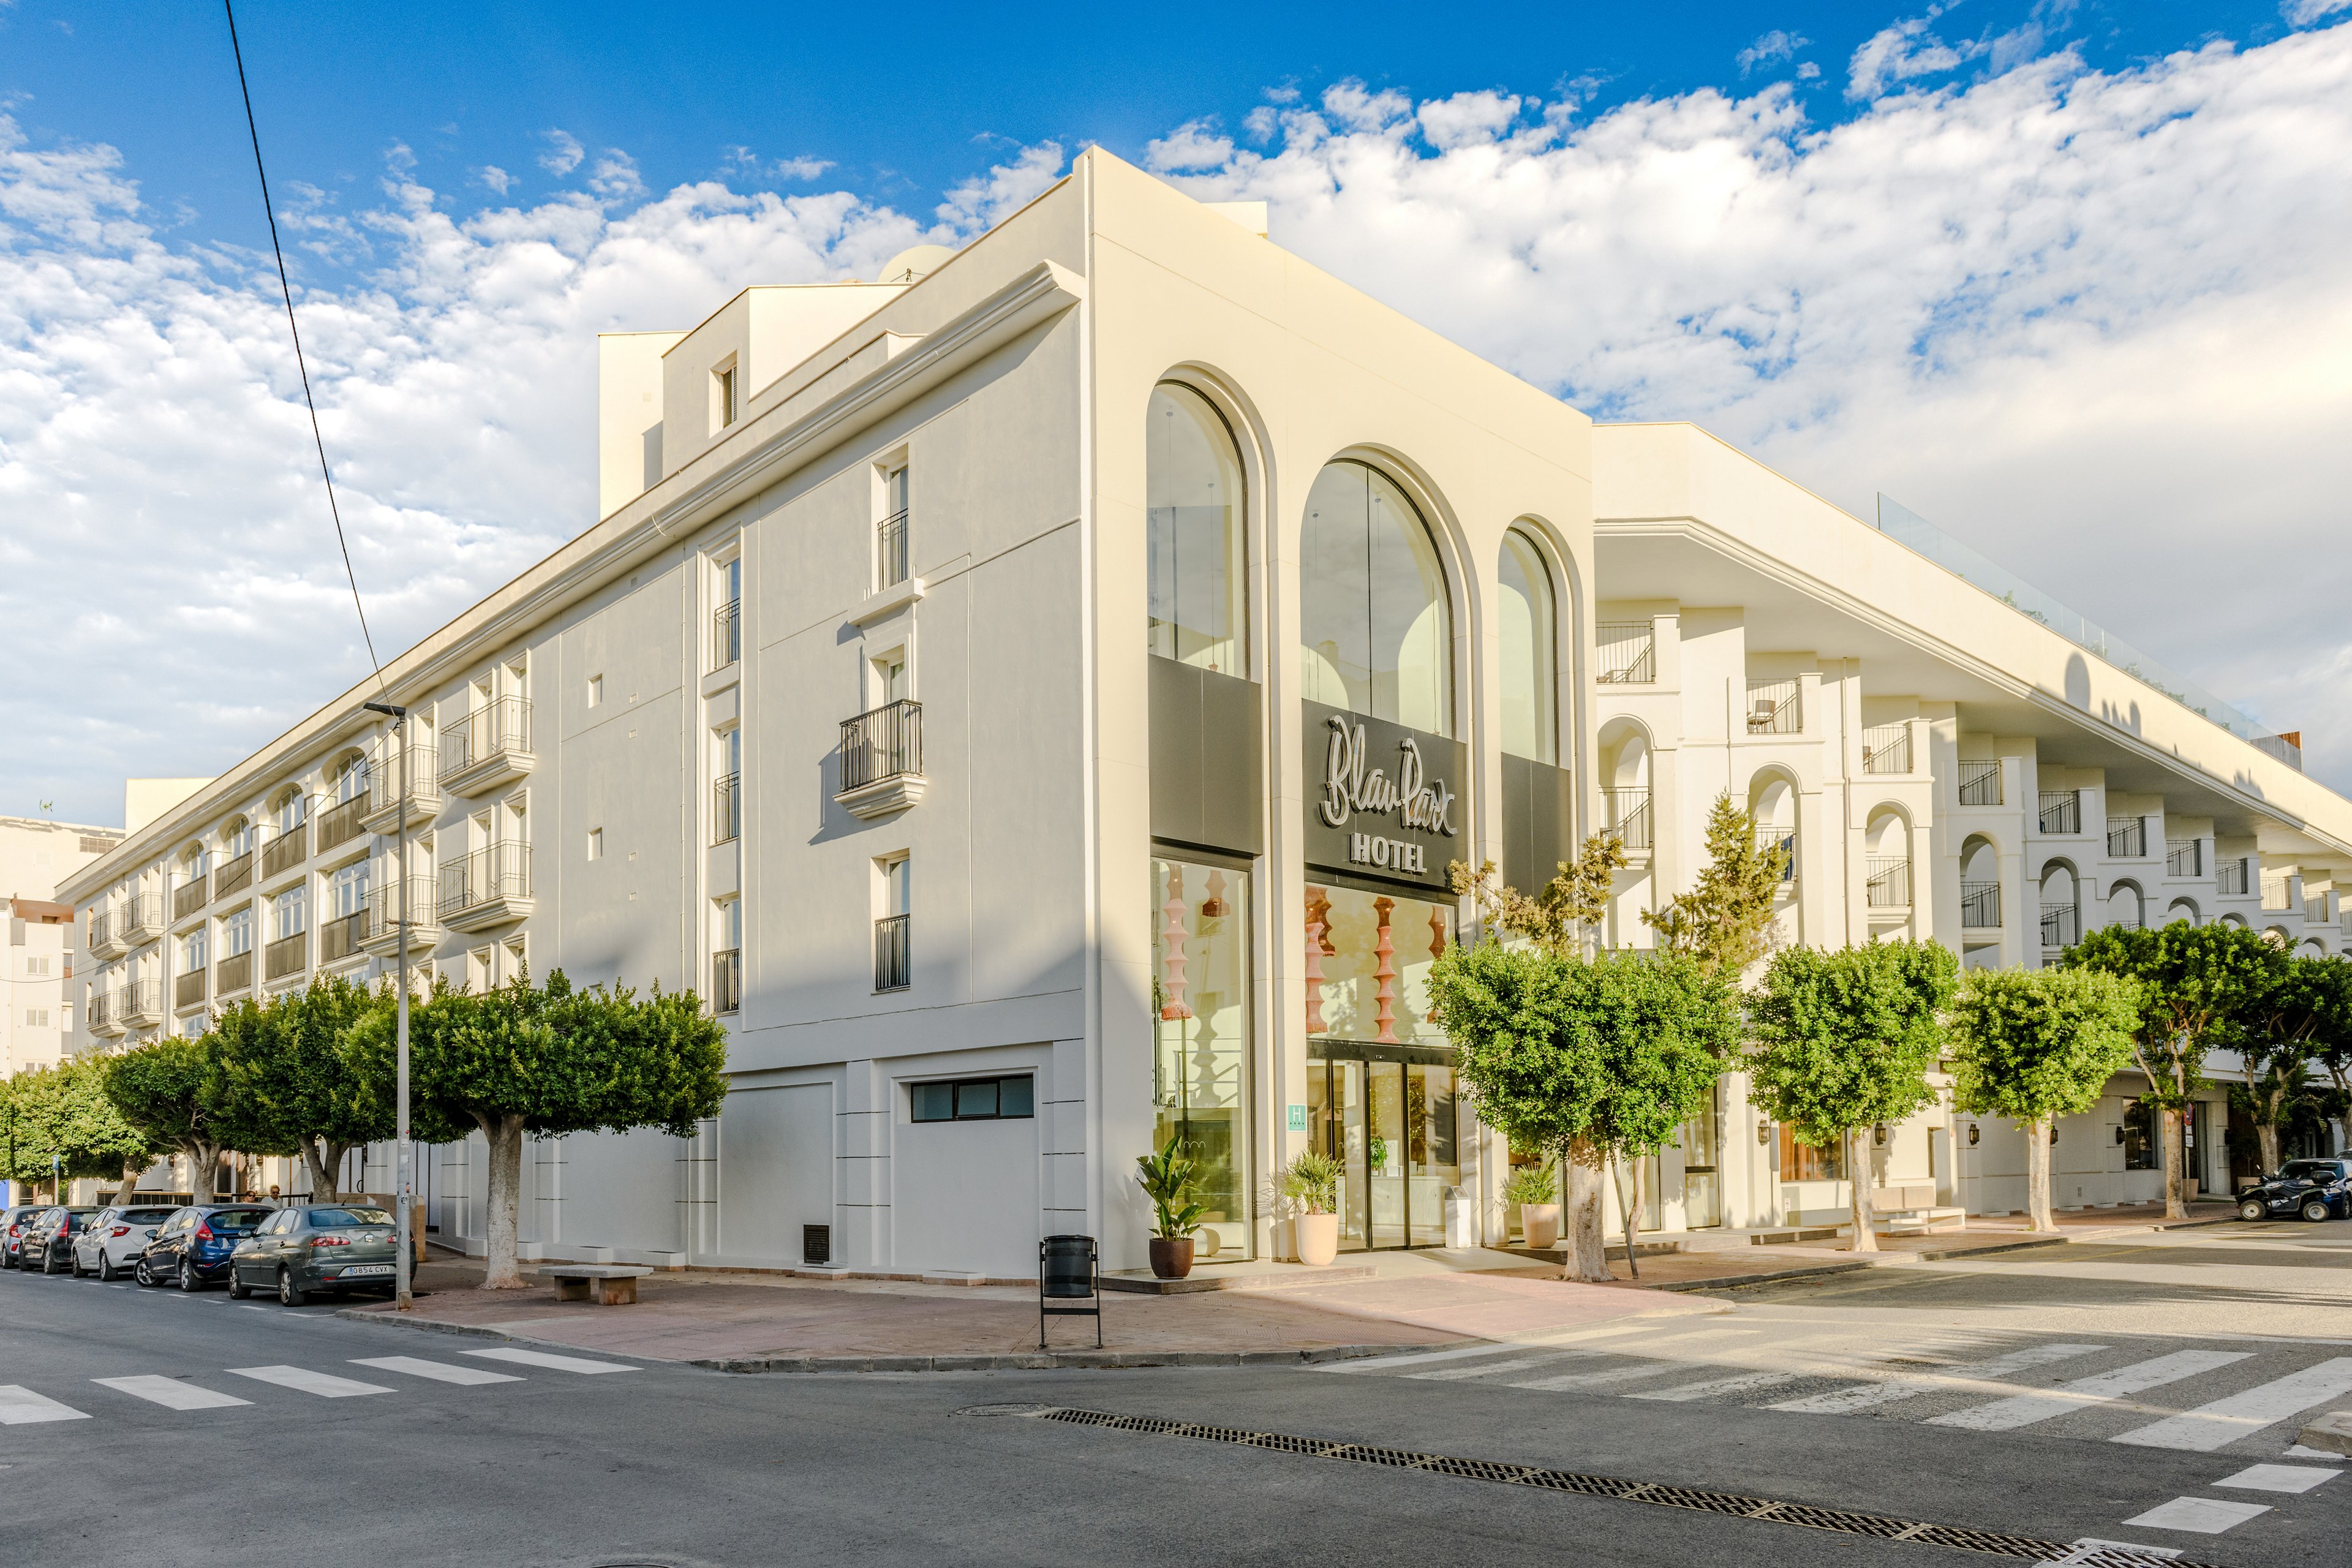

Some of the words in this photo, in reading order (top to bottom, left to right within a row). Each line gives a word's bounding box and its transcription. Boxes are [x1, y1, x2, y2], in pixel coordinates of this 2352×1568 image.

[1320, 715, 1401, 826] Blau
[1349, 832, 1428, 873] HOTEL
[1293, 1107, 1301, 1121] H
